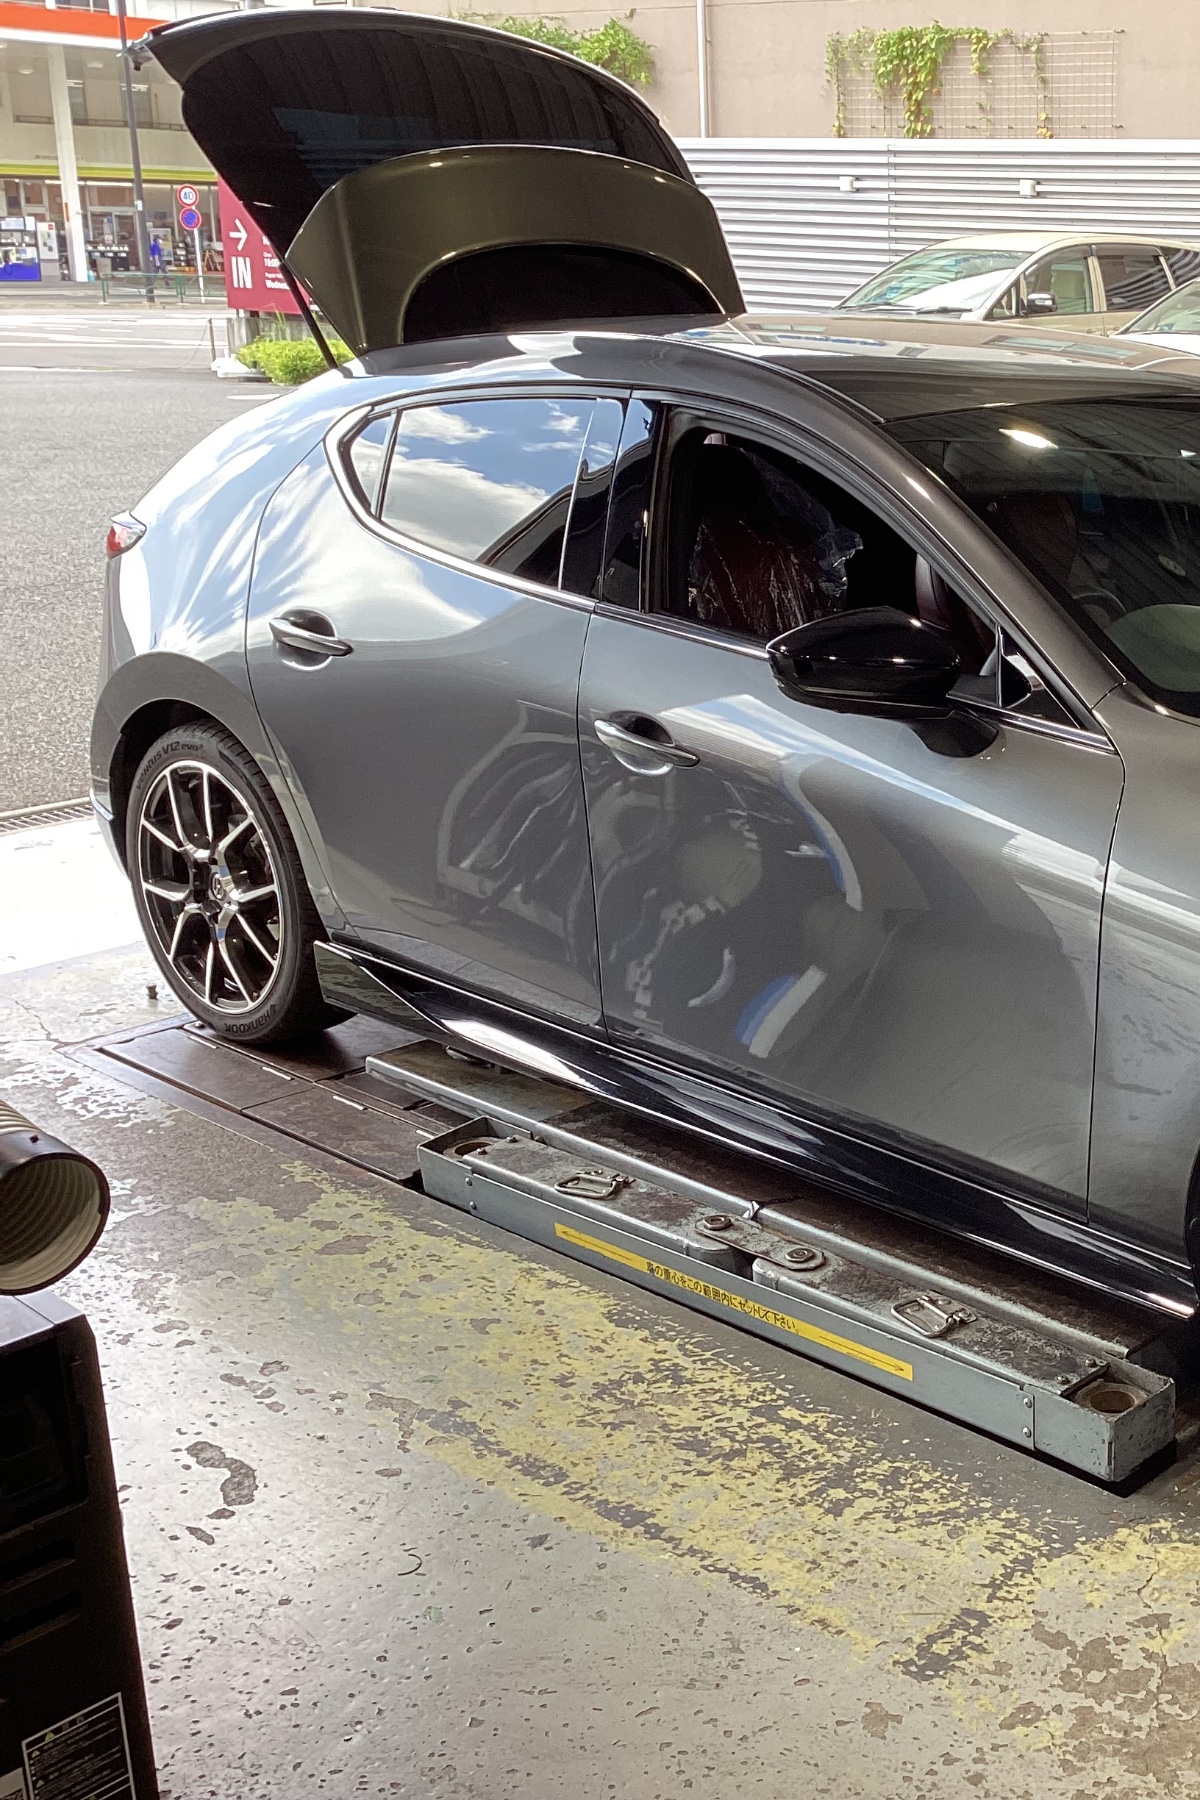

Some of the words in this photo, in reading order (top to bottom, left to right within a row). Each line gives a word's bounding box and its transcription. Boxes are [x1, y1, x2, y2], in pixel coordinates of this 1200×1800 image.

[183, 191, 194, 200] 40
[231, 256, 253, 289] IN
[162, 741, 180, 755] V12
